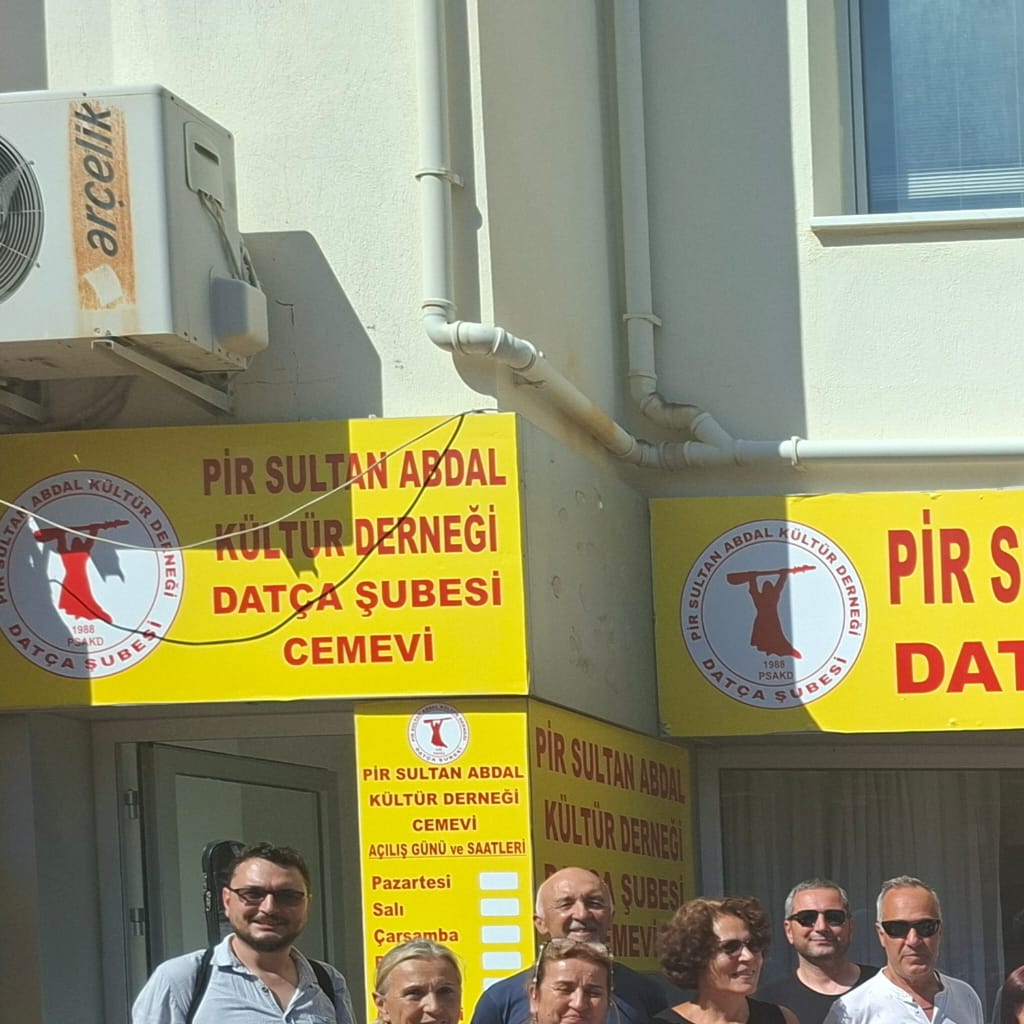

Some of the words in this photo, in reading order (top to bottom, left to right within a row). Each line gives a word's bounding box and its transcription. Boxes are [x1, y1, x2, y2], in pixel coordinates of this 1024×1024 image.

[75, 102, 124, 256] arçelik
[203, 448, 254, 495] PİR
[265, 447, 388, 493] SULTAN
[399, 447, 506, 489] ABDAL
[32, 479, 83, 507] ABDAL
[89, 478, 150, 520] KÜLTÜR
[151, 519, 179, 599] DERNEĞİ
[215, 512, 344, 561] KÜLTÜR
[355, 504, 498, 555] DERNEĞİ
[724, 528, 773, 552] ABDAL
[779, 526, 837, 564] KÜLTÜR
[888, 509, 974, 604] PİR
[213, 582, 342, 619] DATÇA
[356, 571, 501, 617] ŞUBESİ
[689, 551, 722, 609] SULTAN
[836, 565, 862, 636] DERNEĞİ
[9, 624, 75, 670] DATÇA
[84, 620, 162, 672] ŞUBESİ
[72, 625, 95, 634] 1988
[284, 627, 434, 665] CEMEVİ
[687, 614, 702, 641] PİR
[702, 658, 765, 700] DATÇA
[775, 656, 847, 703] ŞUBESİ
[758, 671, 793, 680] PSAKD
[763, 660, 785, 669] 1988
[363, 766, 390, 781] PİR
[396, 767, 462, 780] SULTAN
[467, 766, 524, 779] ABDAL
[535, 720, 566, 775] PİR
[571, 737, 635, 791] SULTAN
[640, 758, 686, 804] ABDAL
[369, 791, 438, 807] KÜLTÜR
[443, 789, 519, 804] DERNEĞİ
[412, 815, 477, 832] CEMEVİ
[544, 794, 616, 850] KÜLTÜR
[620, 820, 684, 862] DERNEĞİ
[369, 844, 407, 859] AÇILIŞ
[411, 840, 447, 855] GÜNÜ
[450, 845, 464, 855] ve
[467, 839, 526, 855] SAATLERİ
[372, 875, 451, 890] Pazartesi
[621, 874, 684, 916] ŞUBESİ
[373, 902, 404, 917] Salı
